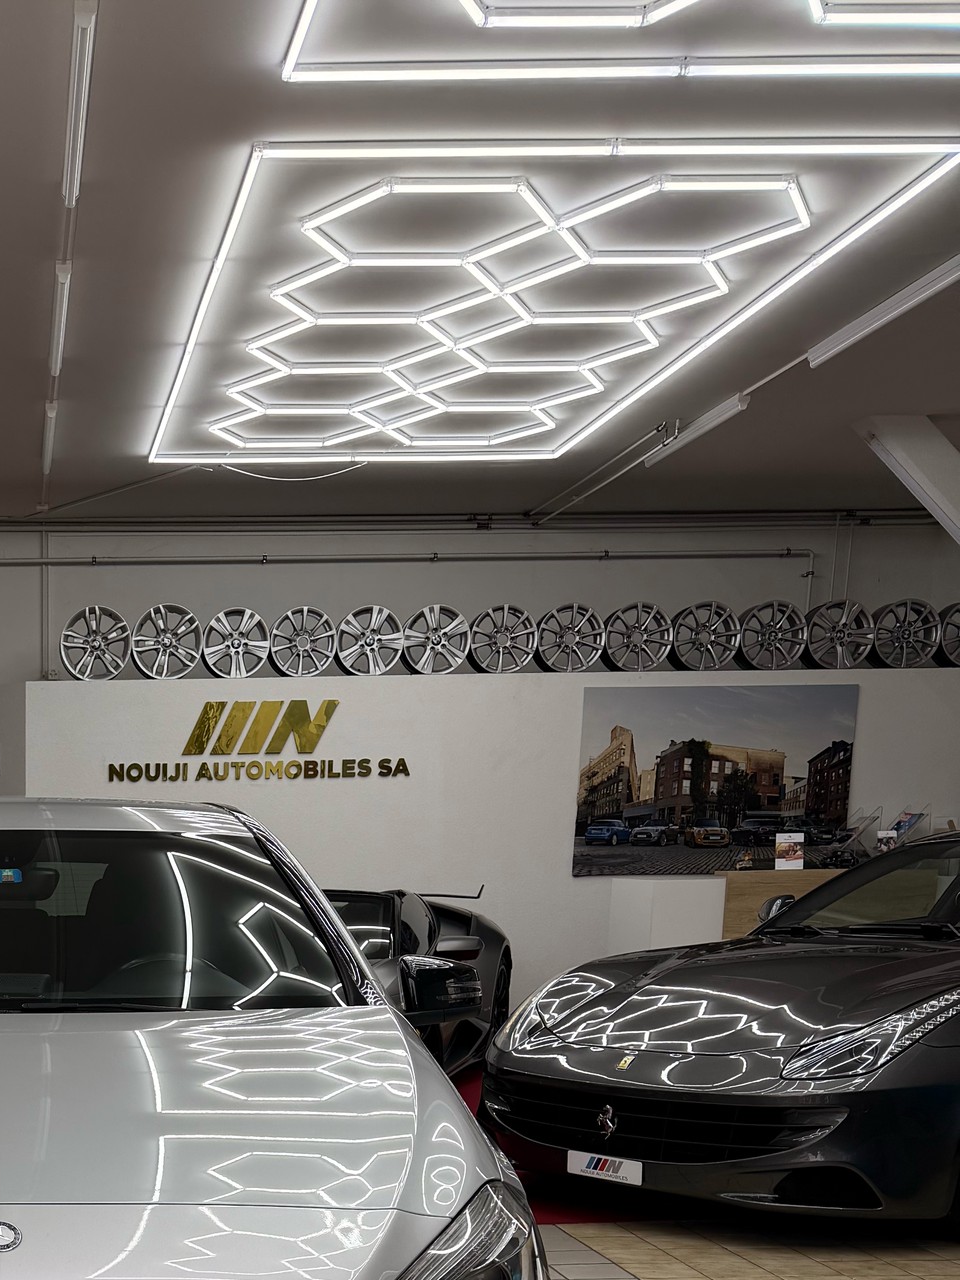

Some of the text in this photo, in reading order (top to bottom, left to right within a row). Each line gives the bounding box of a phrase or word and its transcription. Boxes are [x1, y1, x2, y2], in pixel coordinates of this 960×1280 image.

[108, 757, 411, 782] NOUIJI AUTOMOBILES SA
[596, 1171, 628, 1181] AUTOMOBILES
